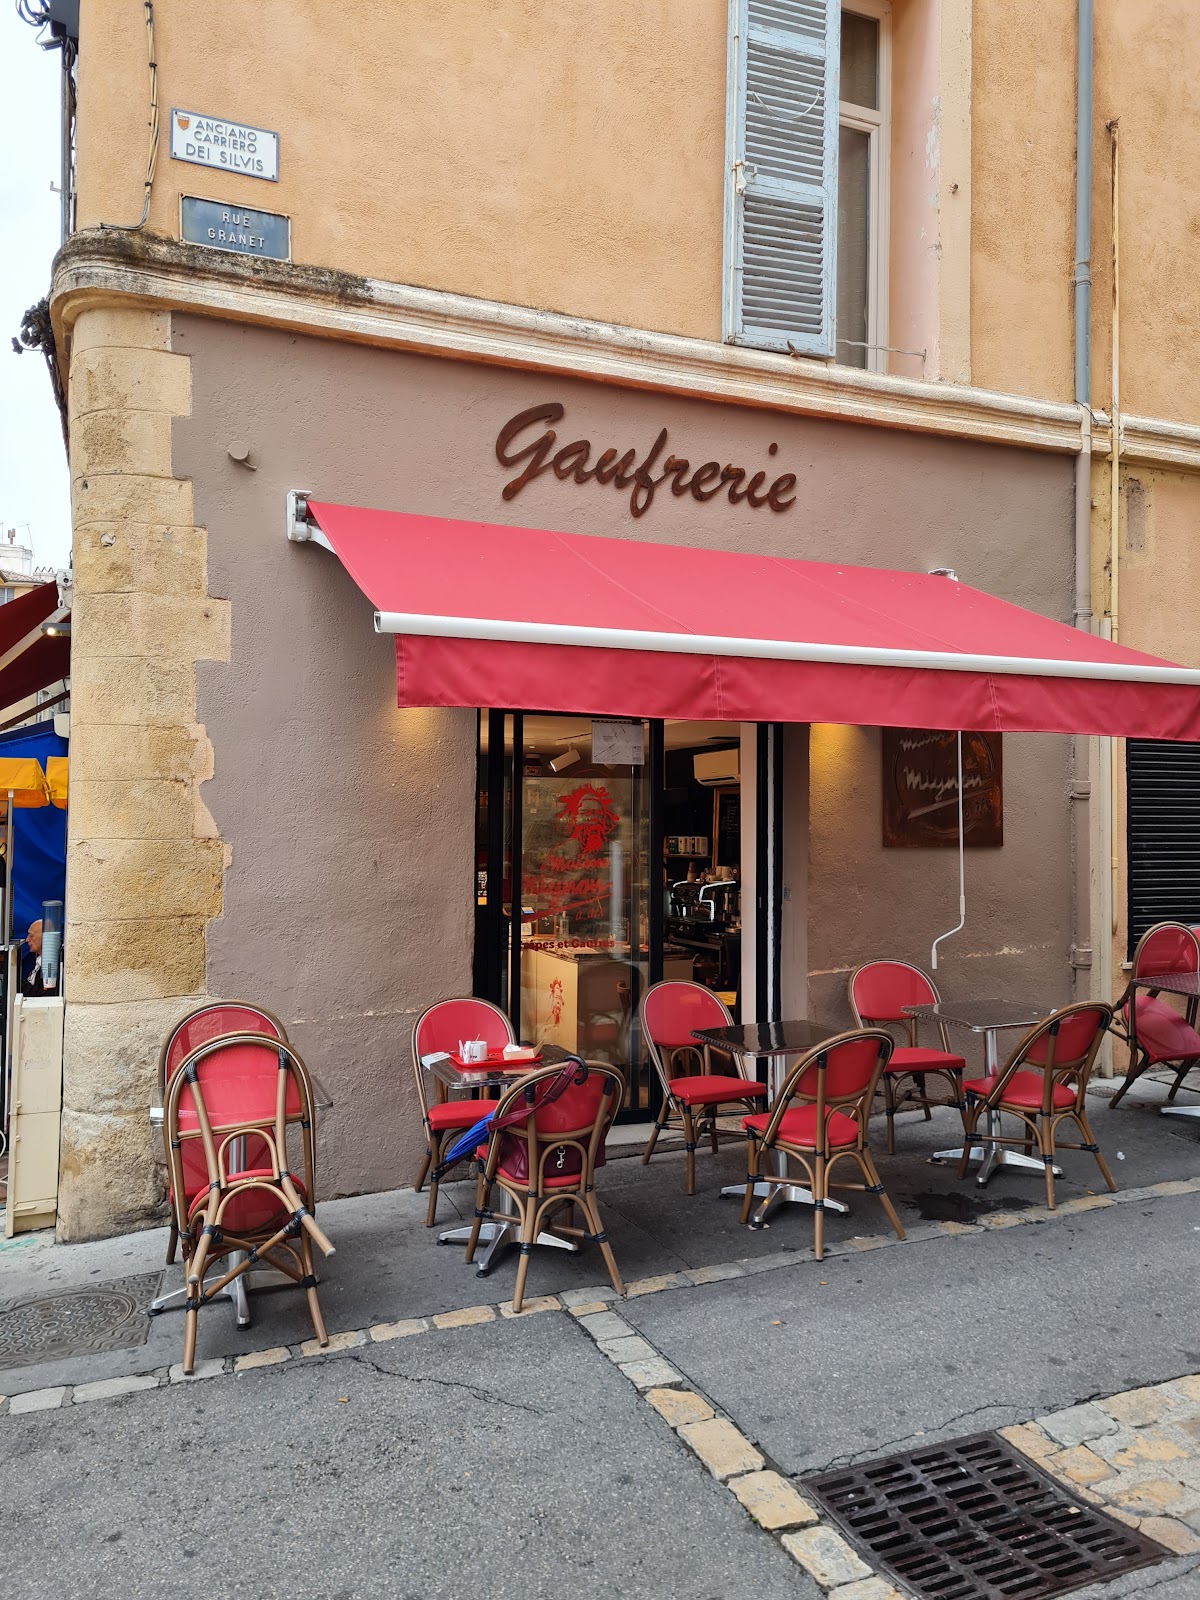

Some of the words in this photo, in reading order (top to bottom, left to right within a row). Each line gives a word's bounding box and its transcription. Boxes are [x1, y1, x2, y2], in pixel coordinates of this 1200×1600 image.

[195, 120, 257, 142] ANCIANO
[194, 131, 257, 154] CARRIERO
[186, 143, 210, 160] DEI
[219, 151, 264, 172] SILVIS
[222, 211, 251, 228] RUE
[207, 228, 265, 249] GRANET
[496, 402, 797, 518] Gaufrerie
[903, 766, 983, 802] Mignon
[520, 940, 555, 951] rêpes
[557, 940, 568, 949] et
